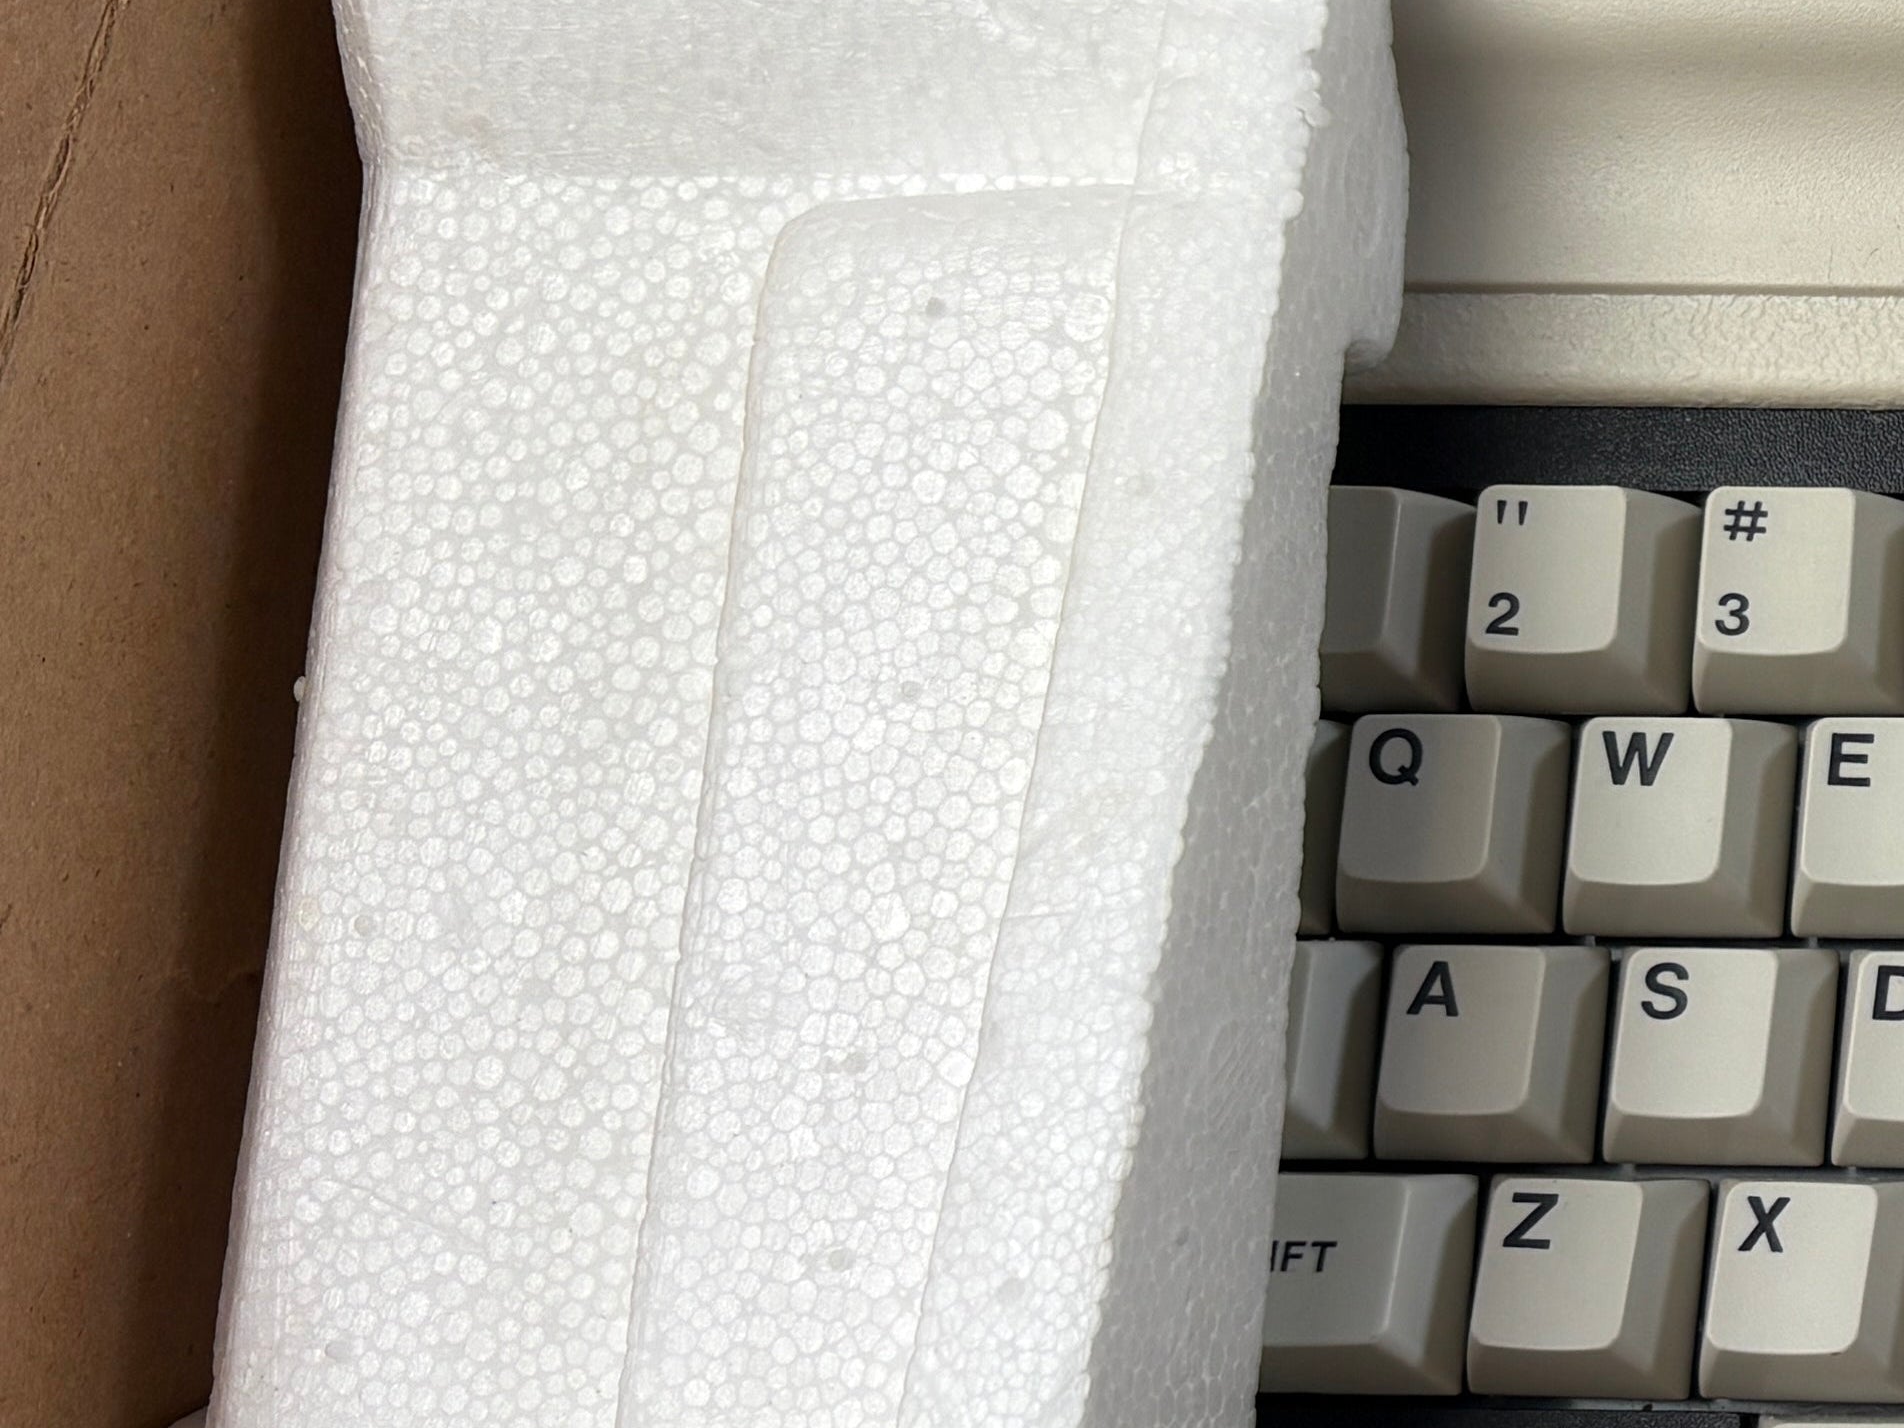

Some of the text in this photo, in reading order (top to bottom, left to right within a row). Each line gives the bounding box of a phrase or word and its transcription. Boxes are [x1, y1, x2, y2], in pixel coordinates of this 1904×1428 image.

[1723, 500, 1768, 542] #
[1485, 592, 1520, 636] 2
[1714, 592, 1750, 636] 3
[1368, 727, 1423, 786] Q
[1601, 730, 1674, 787] W
[1827, 732, 1875, 787] E
[1405, 960, 1462, 1018] A
[1640, 962, 1689, 1020] S
[1502, 1192, 1559, 1250] Z
[1738, 1195, 1791, 1253] X
[1269, 1240, 1338, 1273] IFT
